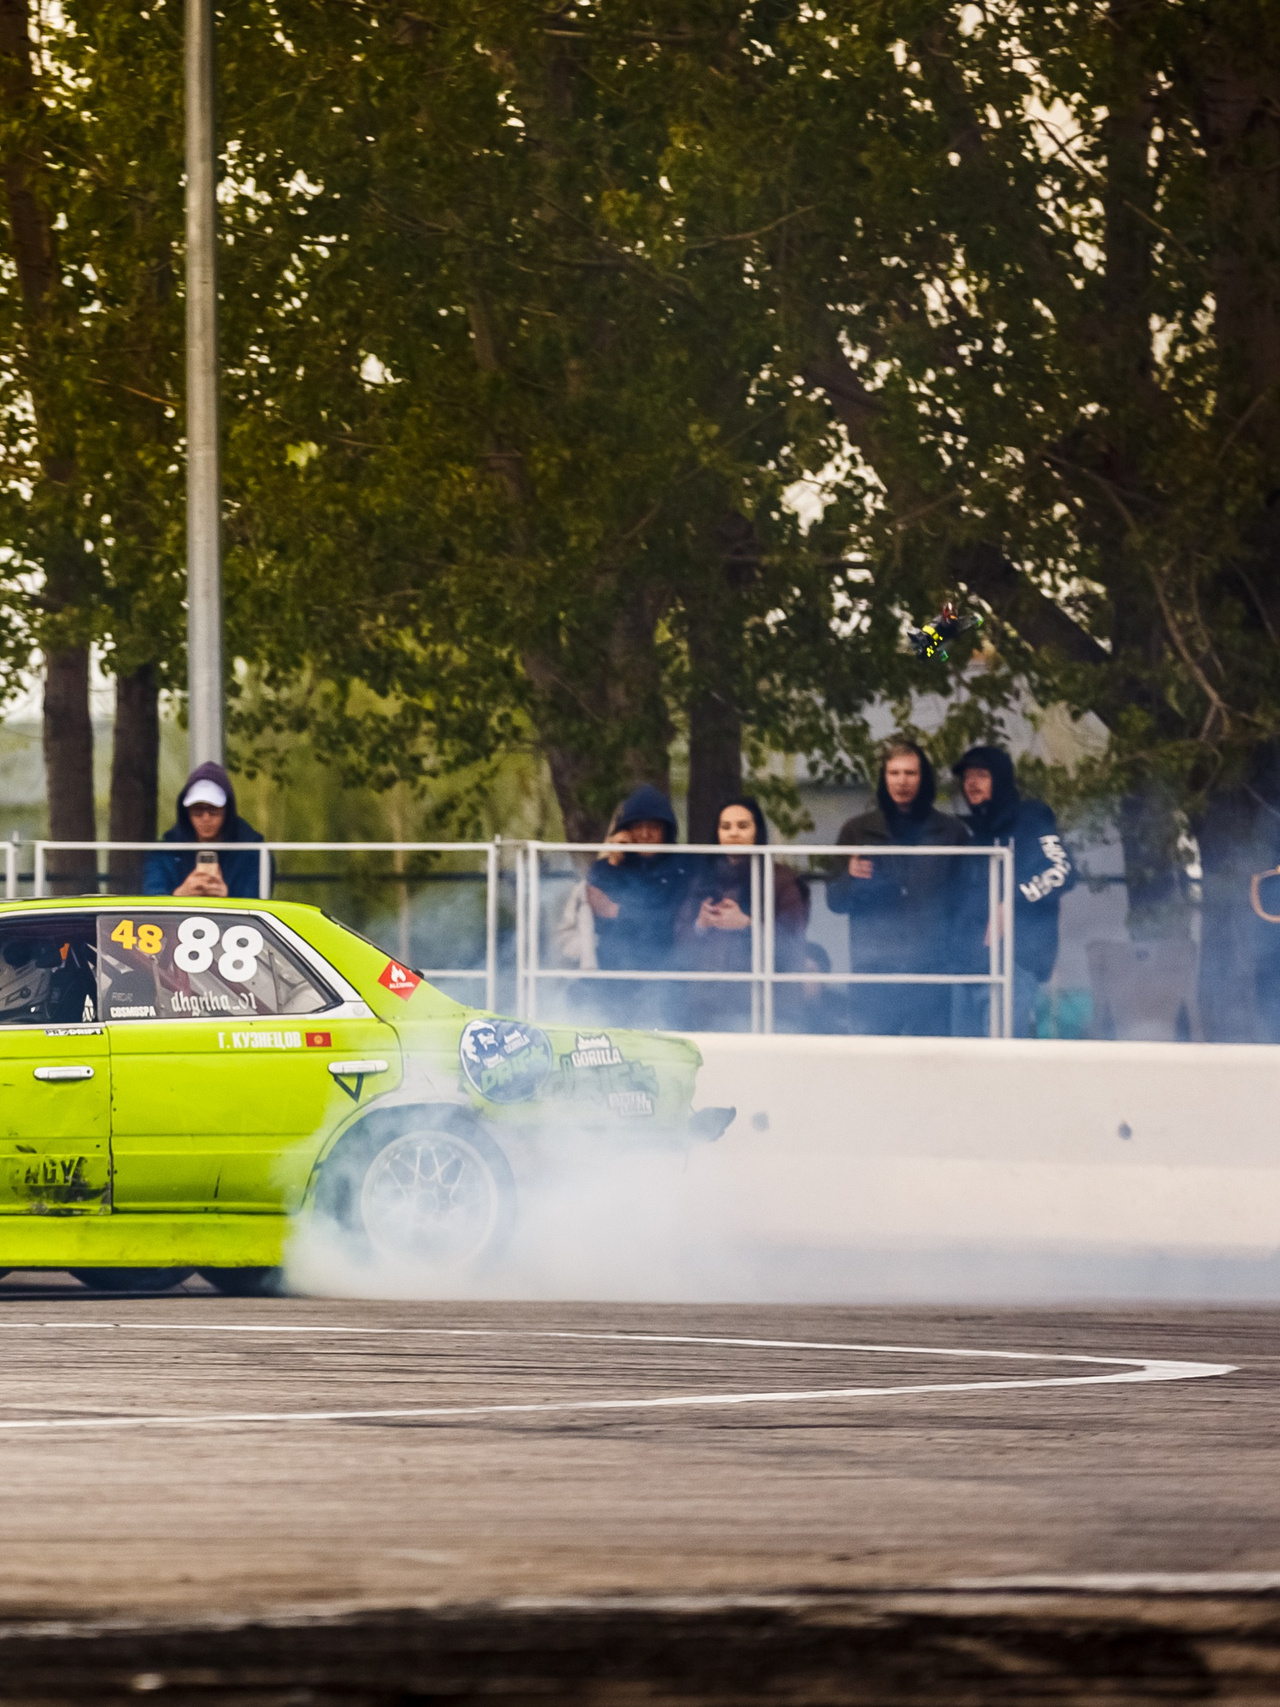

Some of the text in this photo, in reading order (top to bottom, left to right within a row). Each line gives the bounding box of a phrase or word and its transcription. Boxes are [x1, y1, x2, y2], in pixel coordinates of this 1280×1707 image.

[111, 919, 164, 954] 48
[173, 916, 264, 983] 88
[217, 1030, 303, 1051] Г. КУЗНЕЦОВ
[570, 1047, 624, 1069] GORILLA
